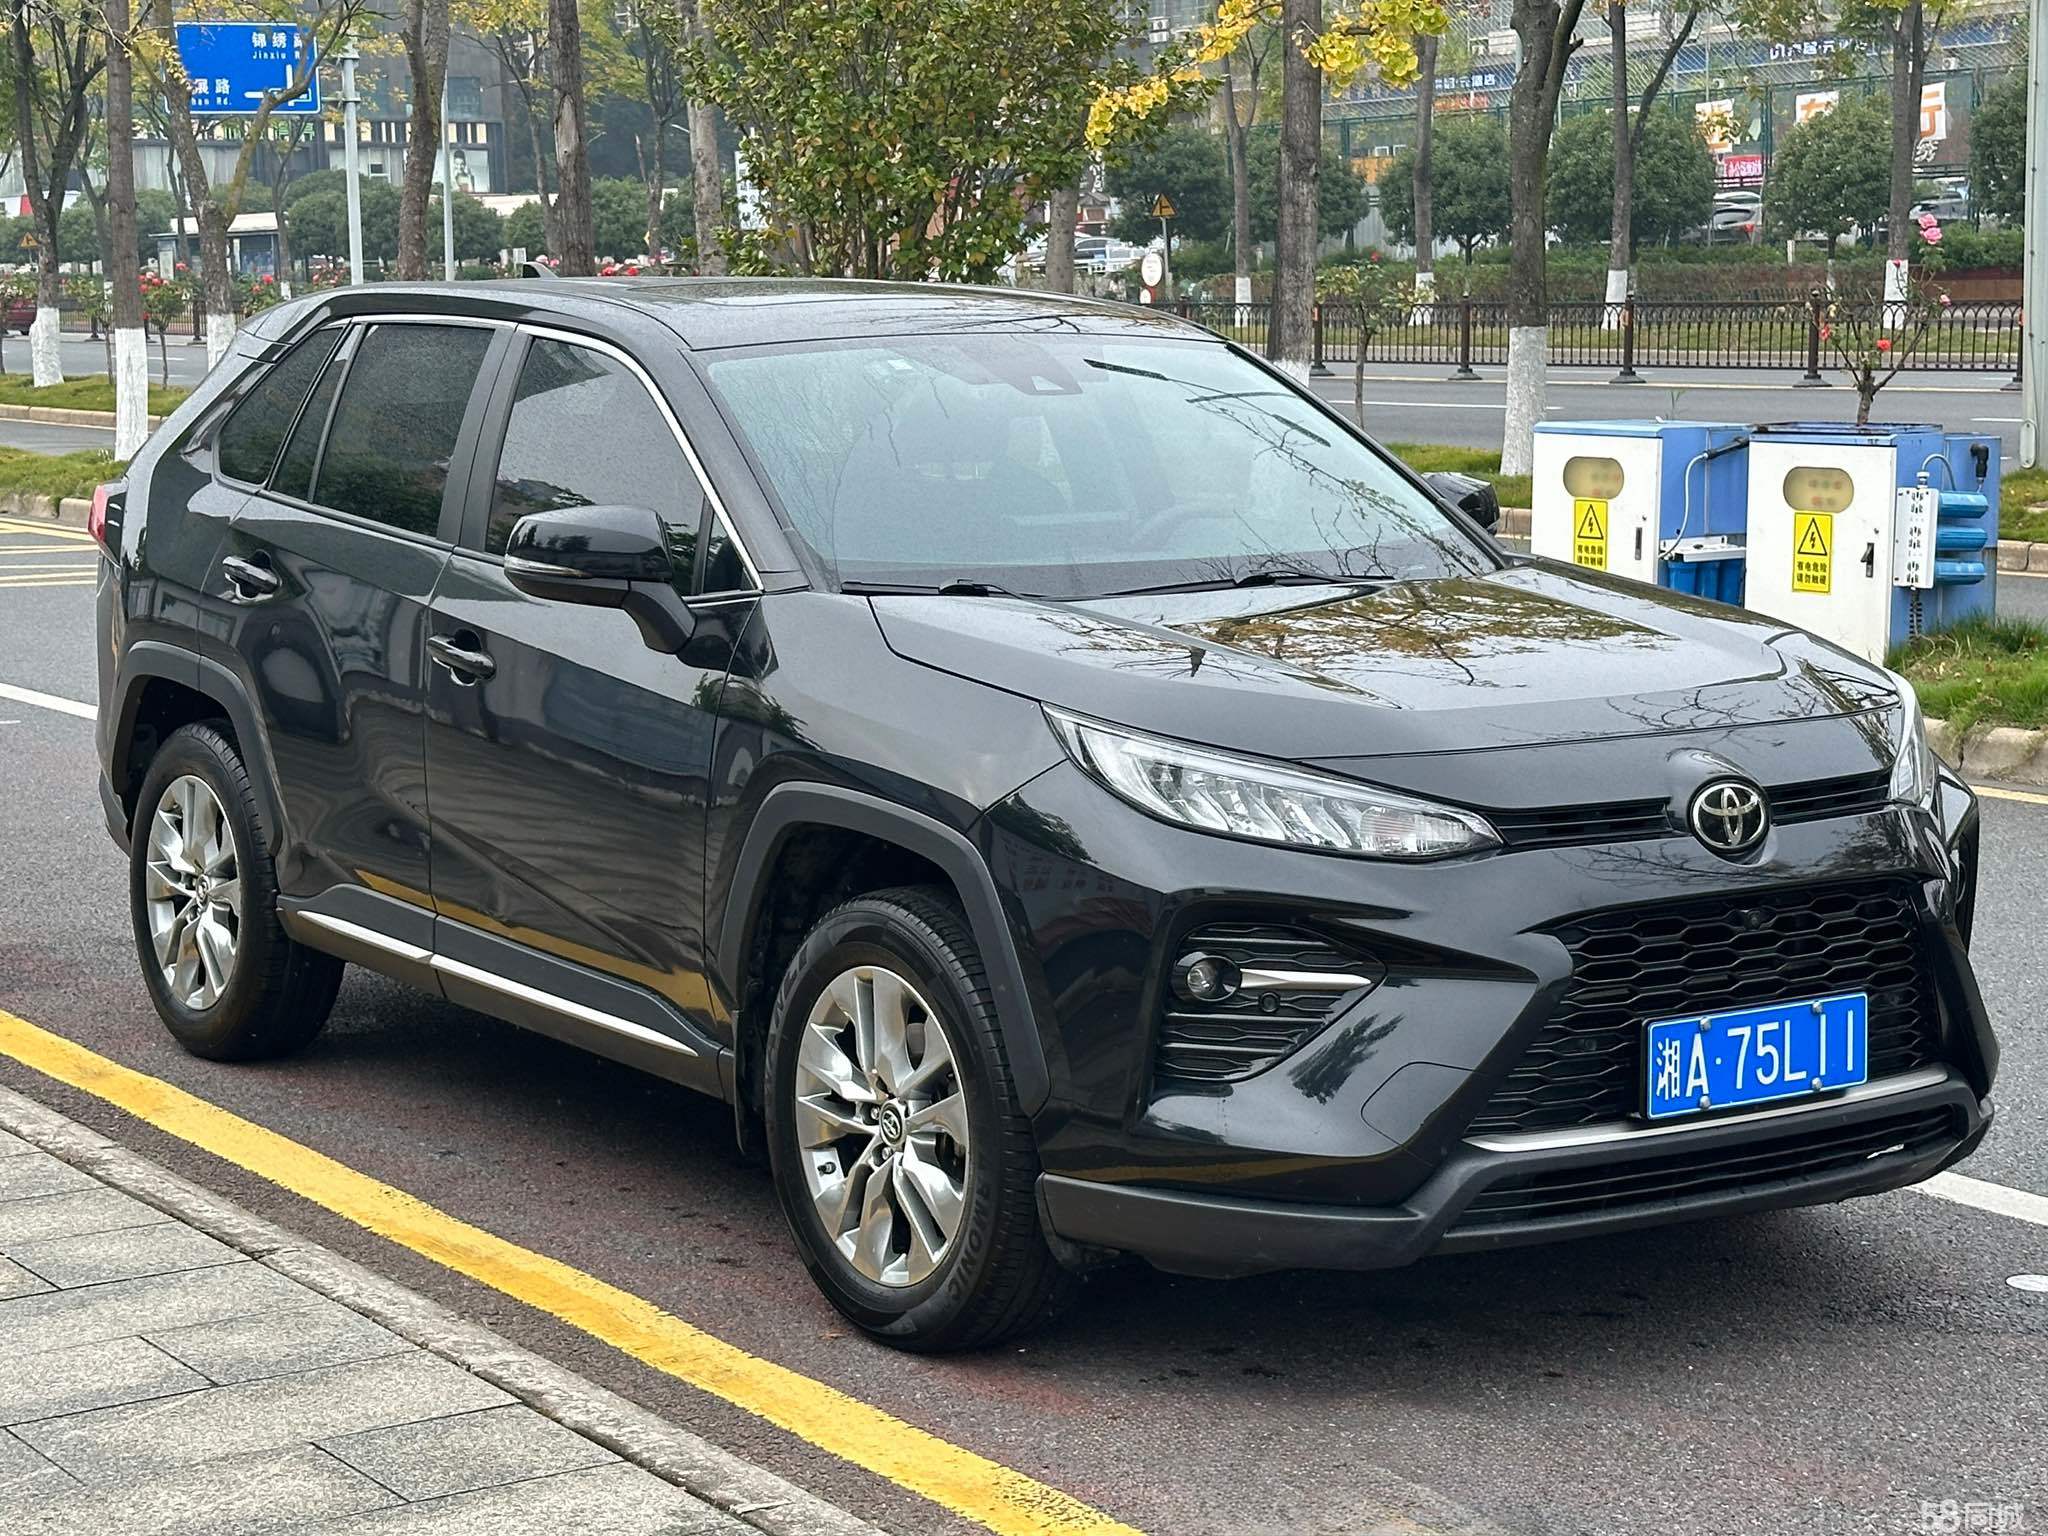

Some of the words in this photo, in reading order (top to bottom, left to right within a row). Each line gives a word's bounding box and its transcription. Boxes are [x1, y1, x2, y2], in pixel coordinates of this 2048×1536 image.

[252, 50, 287, 60] Jinxiu
[216, 96, 233, 106] Rd.
[1797, 561, 1828, 573] 有电危险
